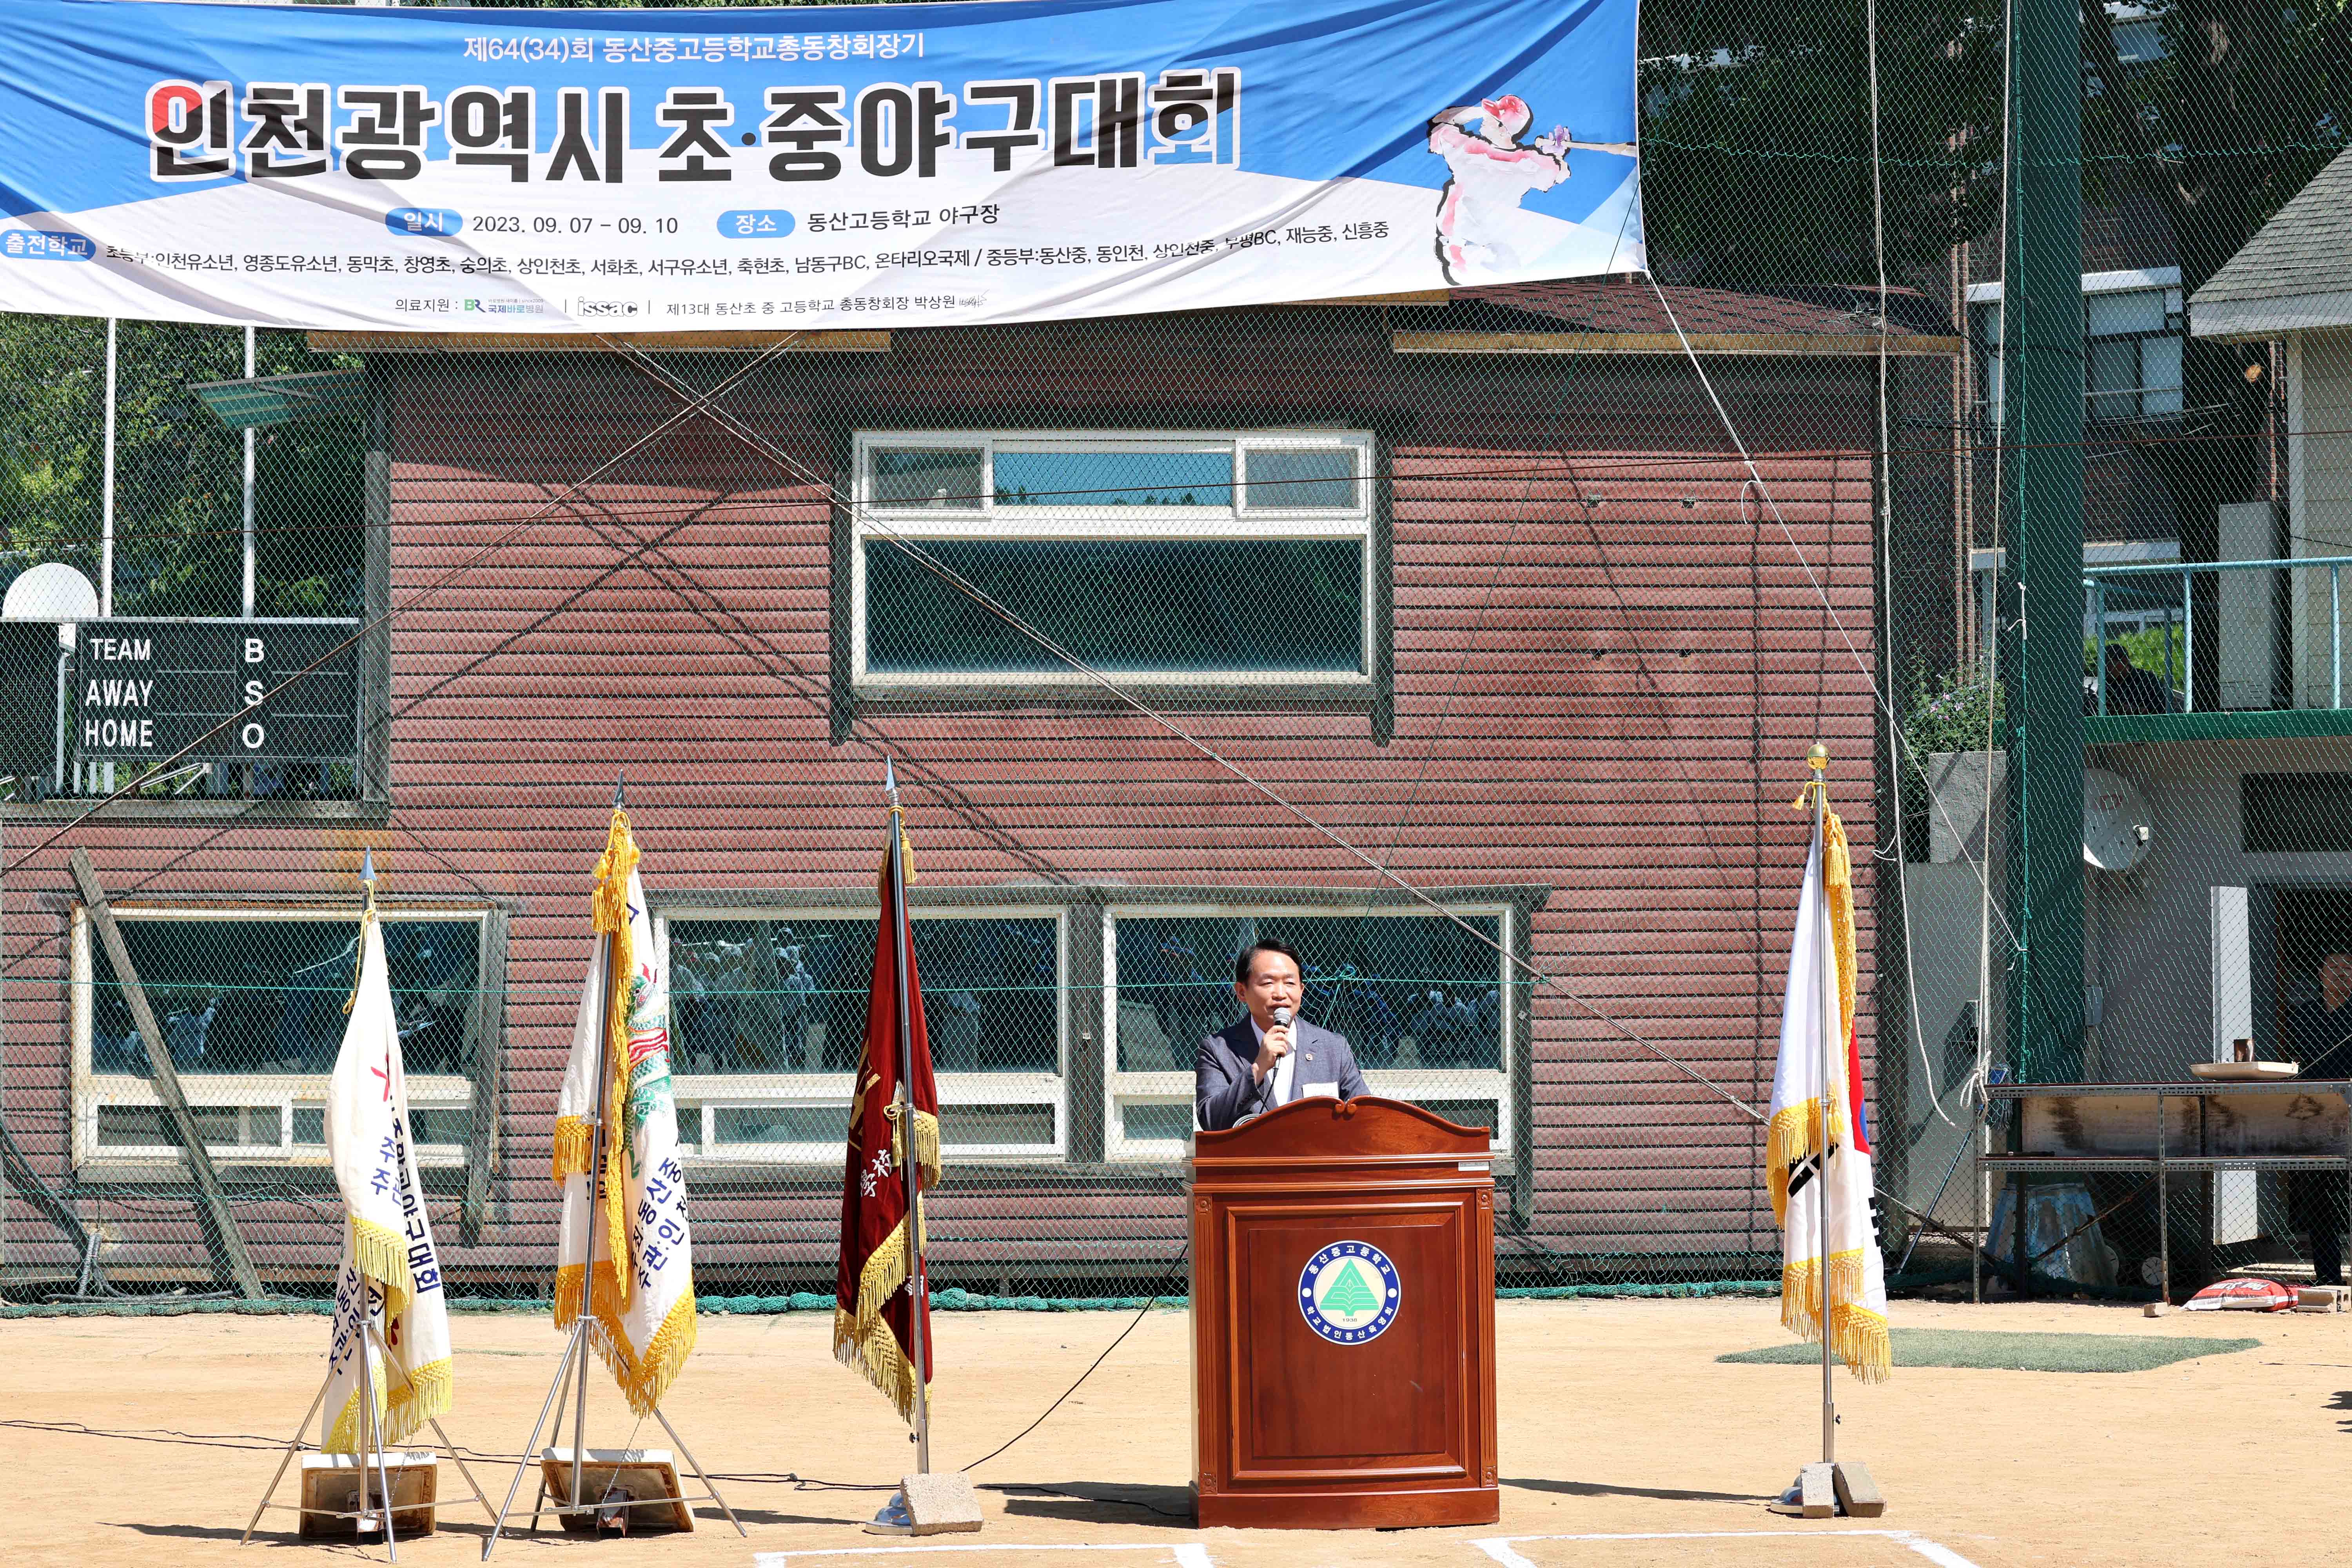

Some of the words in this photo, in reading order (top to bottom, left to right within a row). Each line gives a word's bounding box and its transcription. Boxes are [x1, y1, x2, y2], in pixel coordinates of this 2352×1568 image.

[463, 37, 595, 63] 제64(34)회
[603, 33, 924, 63] 동산중고등학교총동창회장기
[152, 84, 623, 183] 인천광역시
[404, 212, 443, 232] 일시
[473, 216, 525, 233] 2023.
[533, 217, 561, 233] 09.
[570, 218, 592, 233] 07
[618, 218, 646, 234] 09.
[656, 218, 678, 233] 10
[735, 213, 777, 234] 장소
[807, 210, 931, 232] 동산고등학교
[940, 204, 1000, 225] 야구장
[5, 233, 88, 257] 출전학교
[243, 255, 341, 272] 영종도유소년,
[347, 256, 398, 273] 동막초,
[404, 256, 455, 274] 창영초,
[517, 258, 585, 275] 상인천초,
[591, 259, 642, 276] 서화초,
[648, 259, 731, 276] 서구유소년,
[737, 258, 789, 275] 축현초,
[875, 249, 969, 269] 온타리오국제
[1096, 245, 1147, 263] 동인천,
[1342, 221, 1389, 240] 신흥중
[396, 299, 449, 312] 의료지원
[488, 305, 544, 314] 국제바로병원
[666, 303, 710, 316] 제13대
[715, 303, 757, 315] 동산초
[761, 302, 775, 314] 중
[780, 299, 835, 313] 고등학교
[840, 297, 909, 311] 총동창회장
[915, 296, 955, 309] 박상원
[91, 638, 151, 661] TEAM
[245, 638, 265, 662] B
[85, 680, 153, 706] AWAY
[245, 681, 263, 706] S
[85, 720, 152, 747] HOME
[1308, 1245, 1390, 1275] 동산중고등학교
